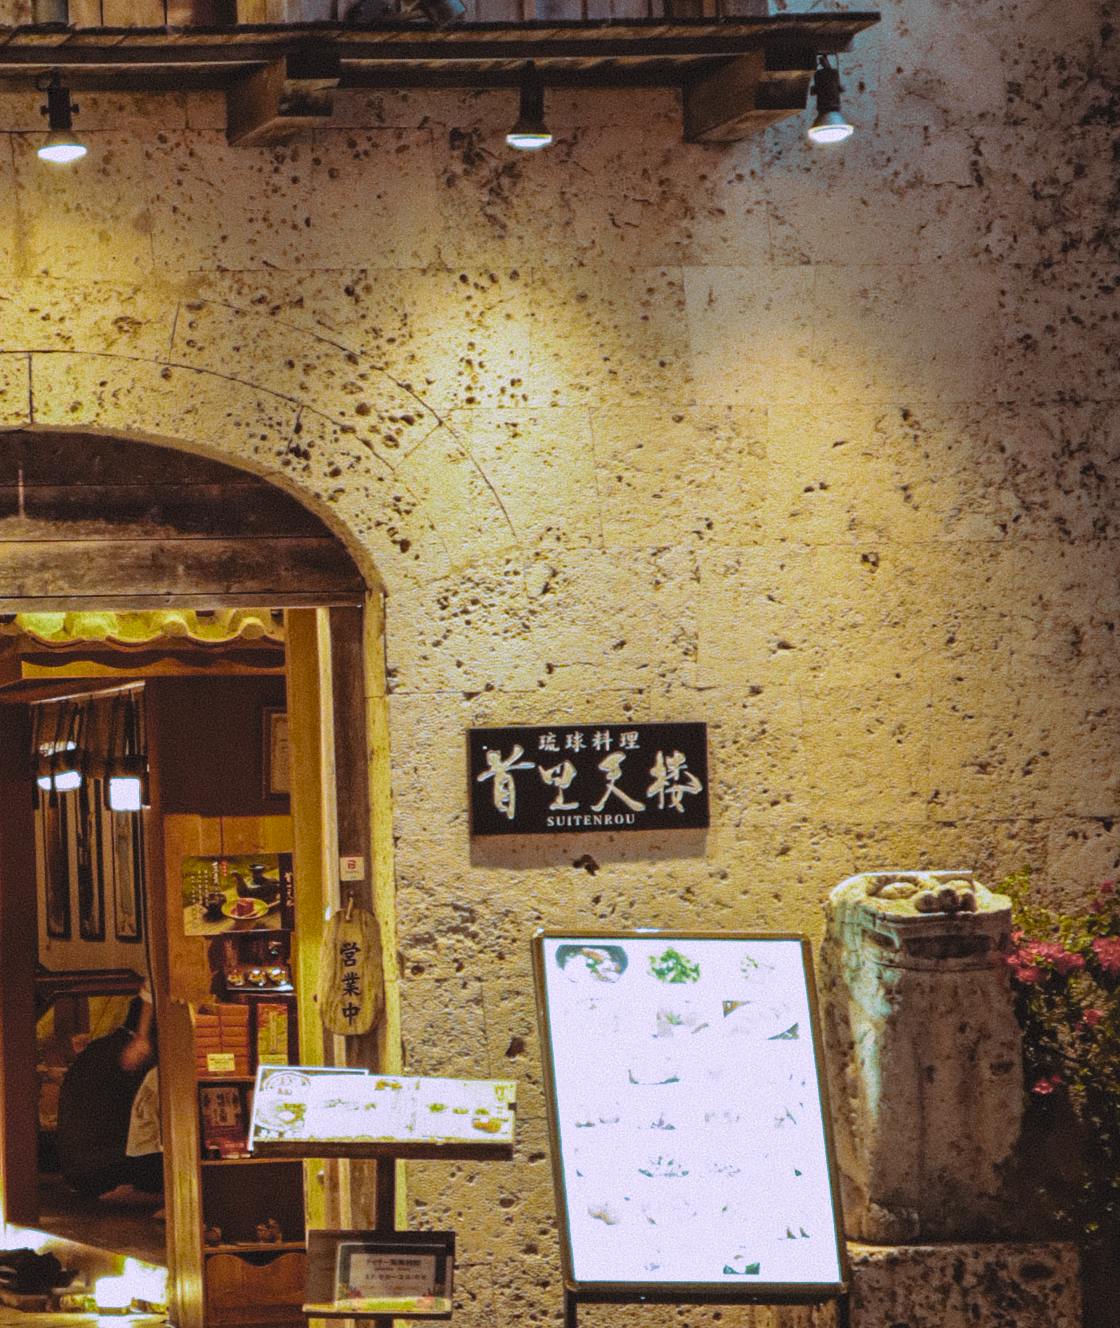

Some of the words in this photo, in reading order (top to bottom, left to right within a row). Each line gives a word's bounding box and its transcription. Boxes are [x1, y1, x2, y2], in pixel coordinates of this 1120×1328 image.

[538, 729, 641, 753] 琉球料理
[546, 813, 637, 828] SUITENROU
[340, 941, 362, 1027] 営業中
